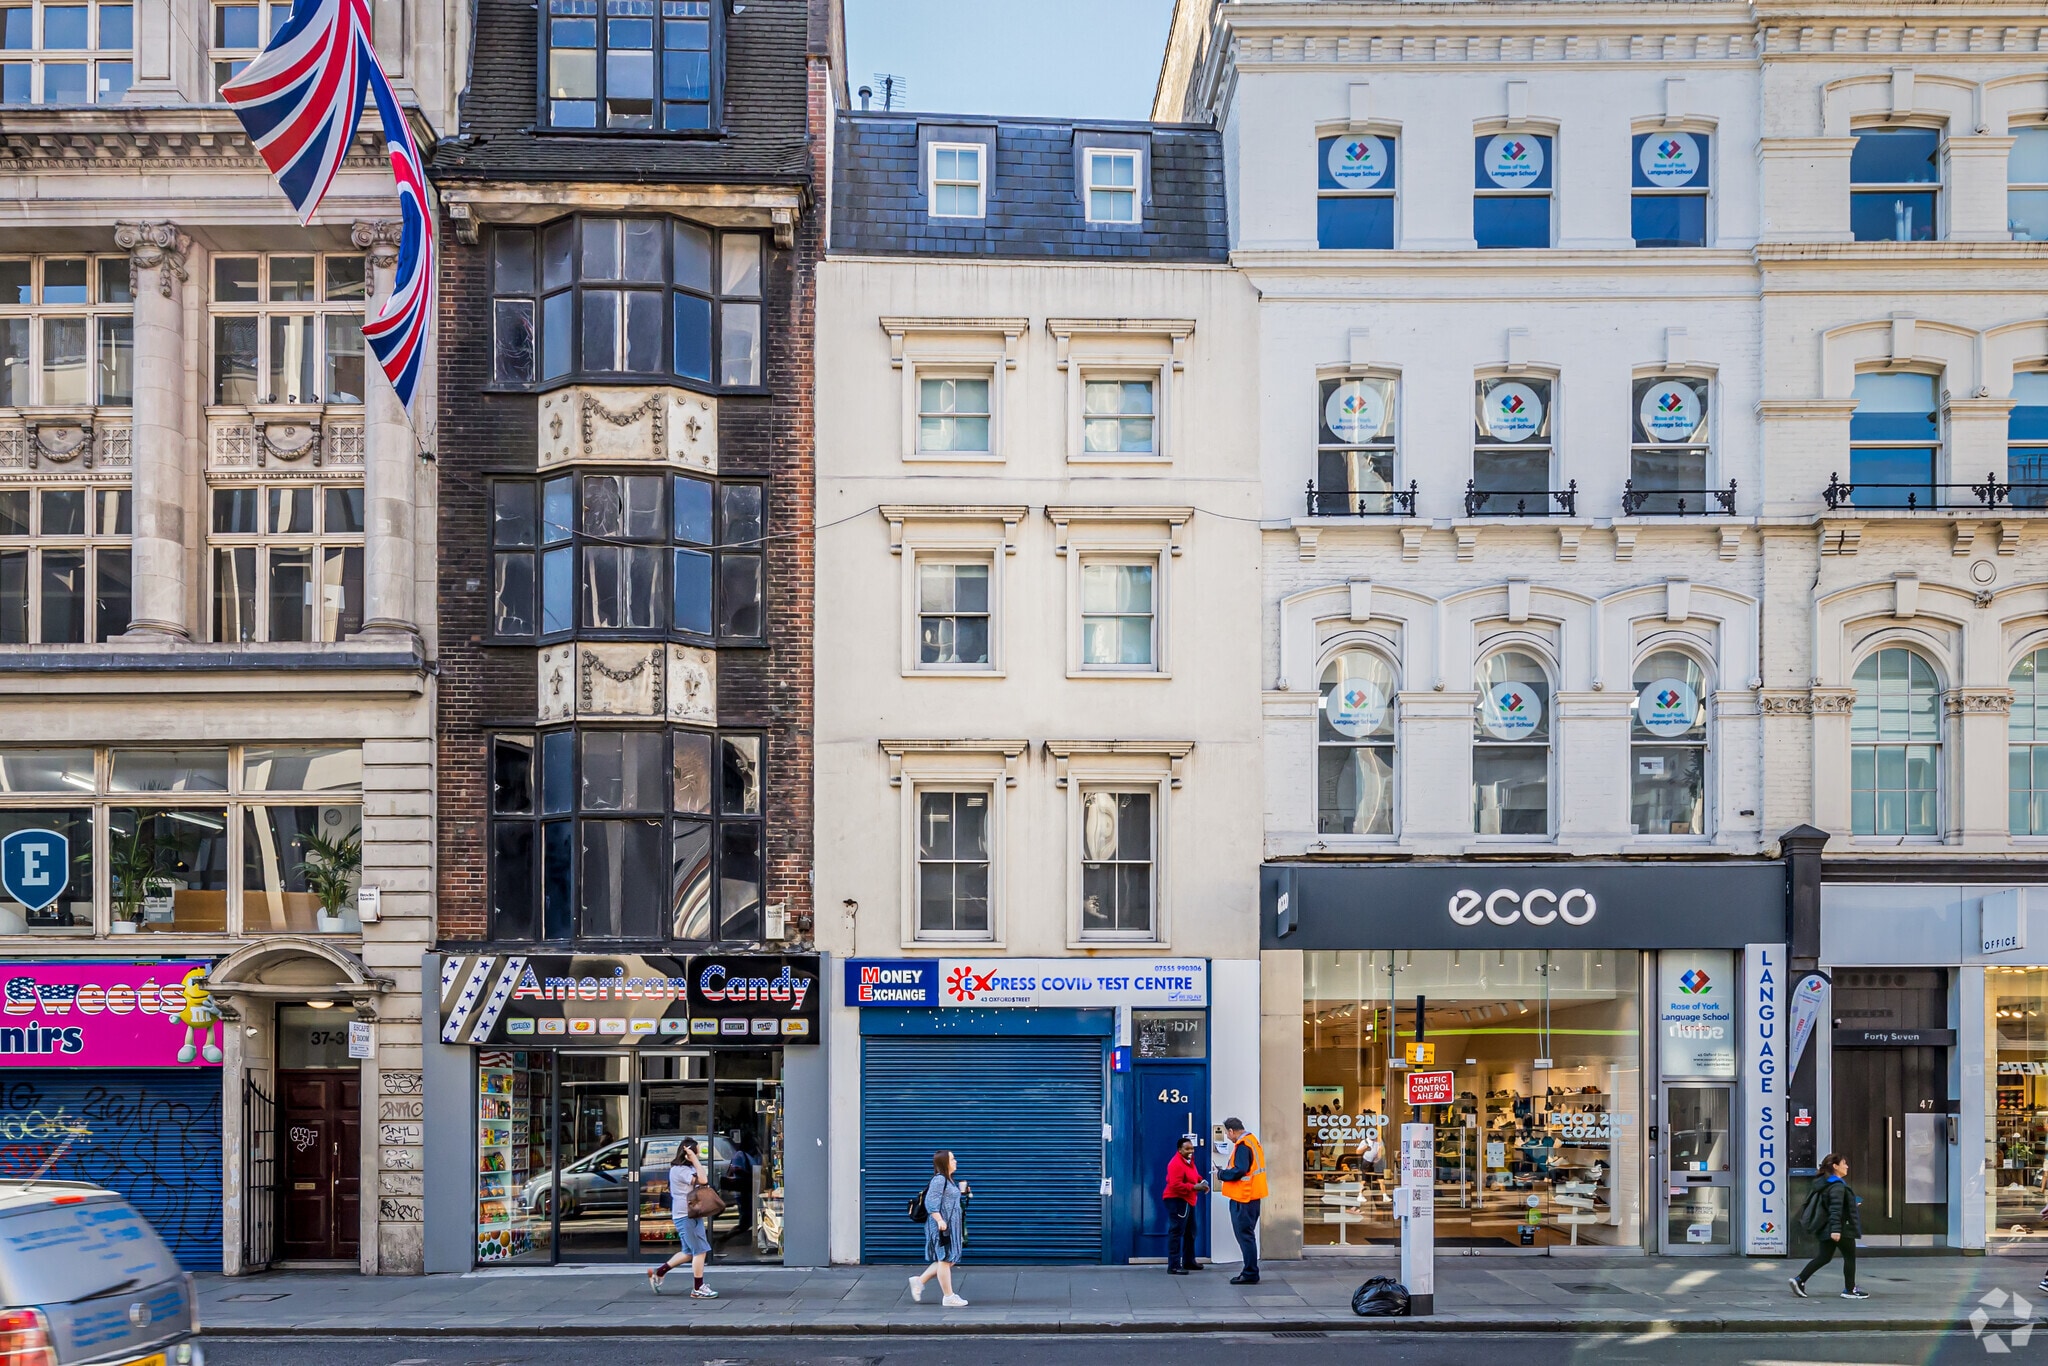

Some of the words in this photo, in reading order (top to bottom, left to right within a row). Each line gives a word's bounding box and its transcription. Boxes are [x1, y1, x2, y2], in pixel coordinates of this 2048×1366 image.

[21, 843, 49, 886] E
[1448, 888, 1597, 926] ecco
[1984, 936, 2016, 950] OFFICE
[862, 966, 922, 984] MONEY
[513, 963, 687, 1001] American
[700, 964, 811, 1011] Candy
[1042, 977, 1092, 990] COVID
[1097, 977, 1130, 990] TEST
[1134, 977, 1192, 990] CENTRE
[3, 977, 187, 1016] Sweets
[858, 984, 926, 1001] EXCHANGE
[1662, 1014, 1700, 1022] Language
[1758, 950, 1774, 1093] LANGUAGE
[310, 1032, 348, 1045] 37-3
[1864, 1033, 1888, 1041] Forty
[1414, 1076, 1447, 1084] TRAFFIC
[1412, 1084, 1450, 1092] CONTROL
[1158, 1089, 1188, 1103] 43a
[1417, 1092, 1444, 1100] AHEAD
[1920, 1100, 1934, 1109] 47
[1308, 1114, 1351, 1127] ECCO
[1355, 1114, 1389, 1127] 2ND
[1551, 1113, 1596, 1125] ECCO
[1599, 1113, 1632, 1125] 2ND
[1318, 1128, 1378, 1140] COZMO
[1562, 1127, 1623, 1138] COZMO
[1413, 1141, 1432, 1149] WELCOME
[1420, 1150, 1425, 1158] TO
[1758, 1107, 1775, 1213] SCHOOL
[1413, 1160, 1432, 1168] LONDON'S
[1413, 1169, 1423, 1178] WEST
